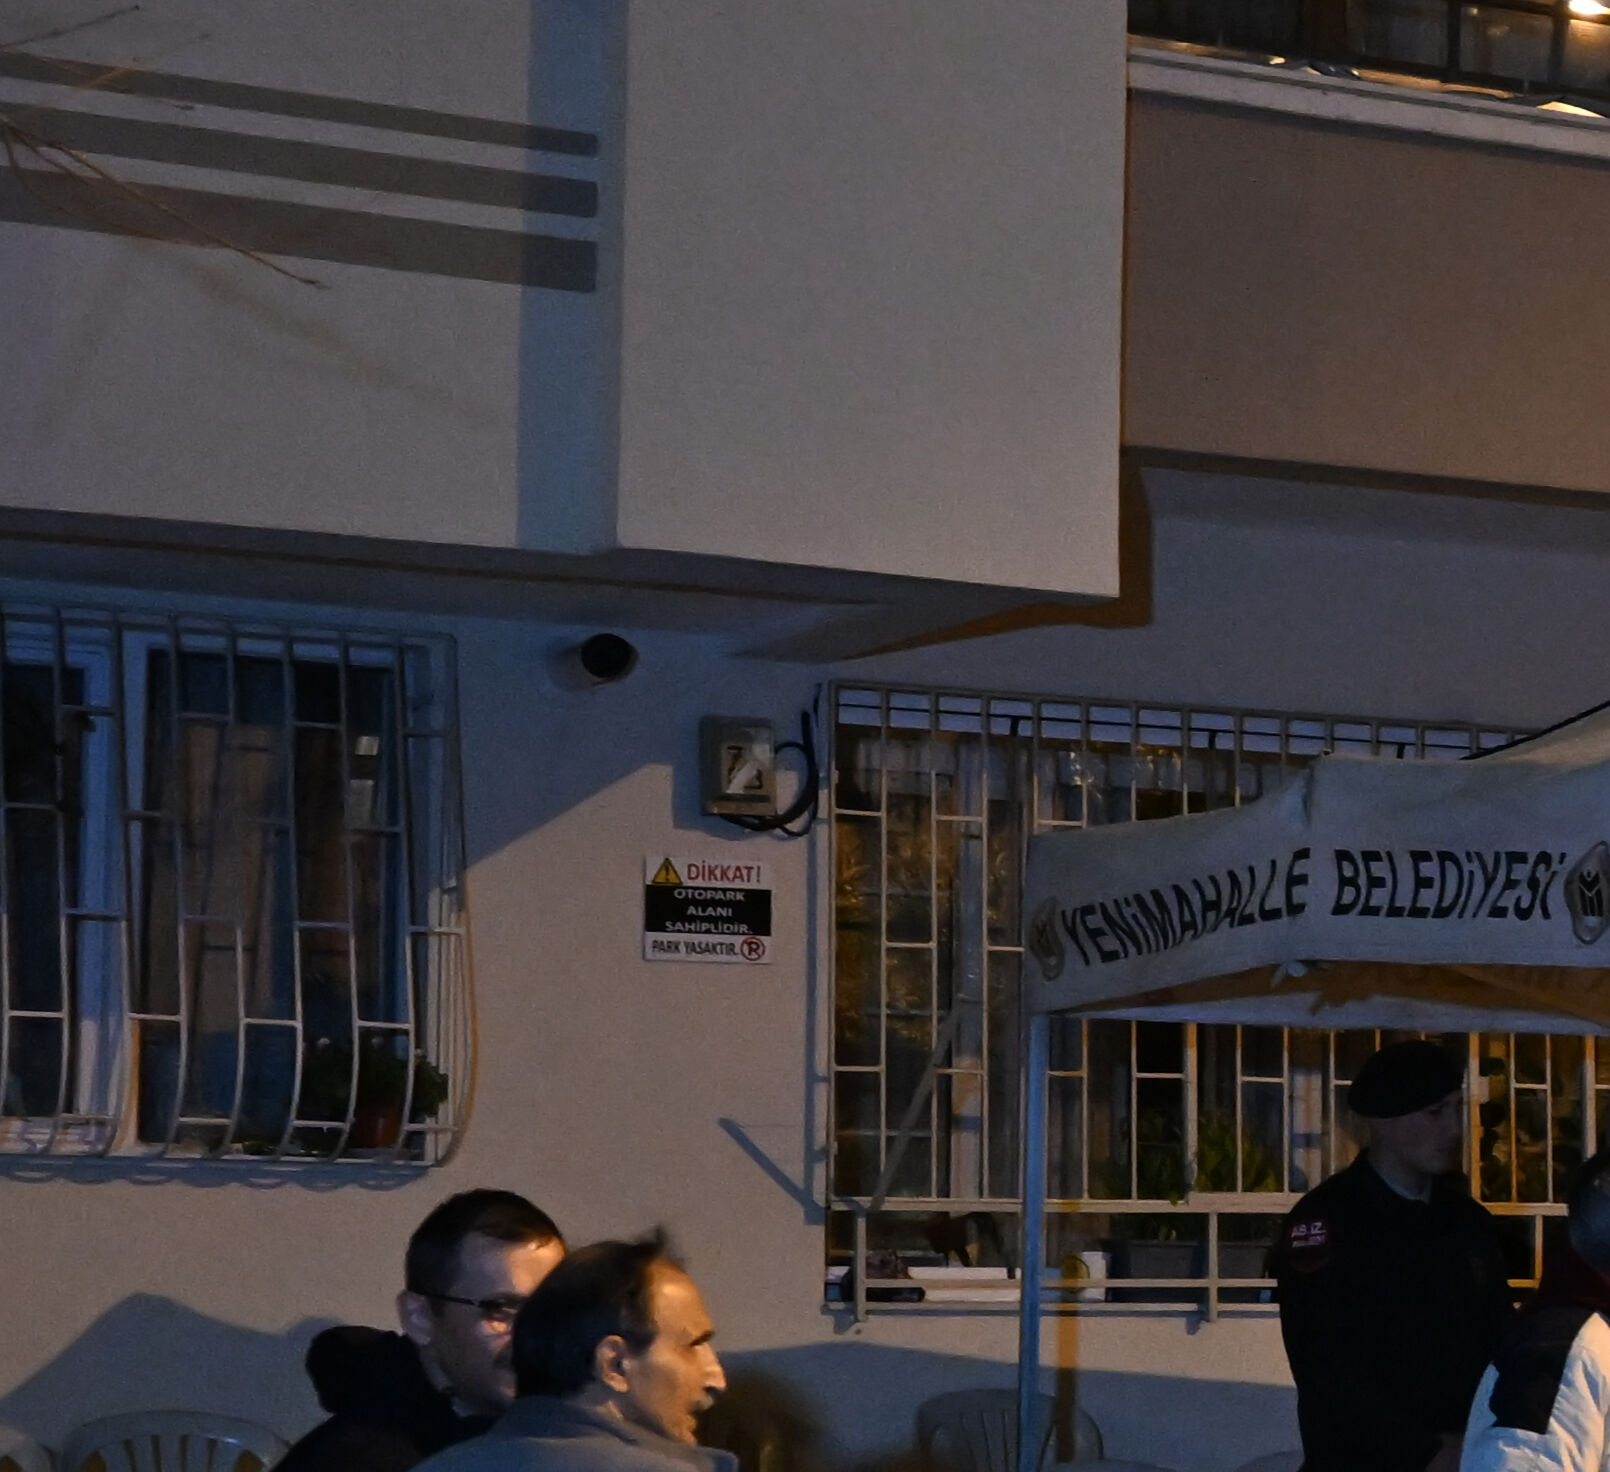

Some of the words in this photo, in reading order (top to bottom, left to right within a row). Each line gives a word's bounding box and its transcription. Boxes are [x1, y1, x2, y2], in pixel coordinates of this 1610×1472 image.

[687, 860, 762, 884] DİKKAT!
[673, 888, 746, 902] OTOPARK
[686, 905, 733, 918] ALANI
[652, 939, 681, 954] PARK
